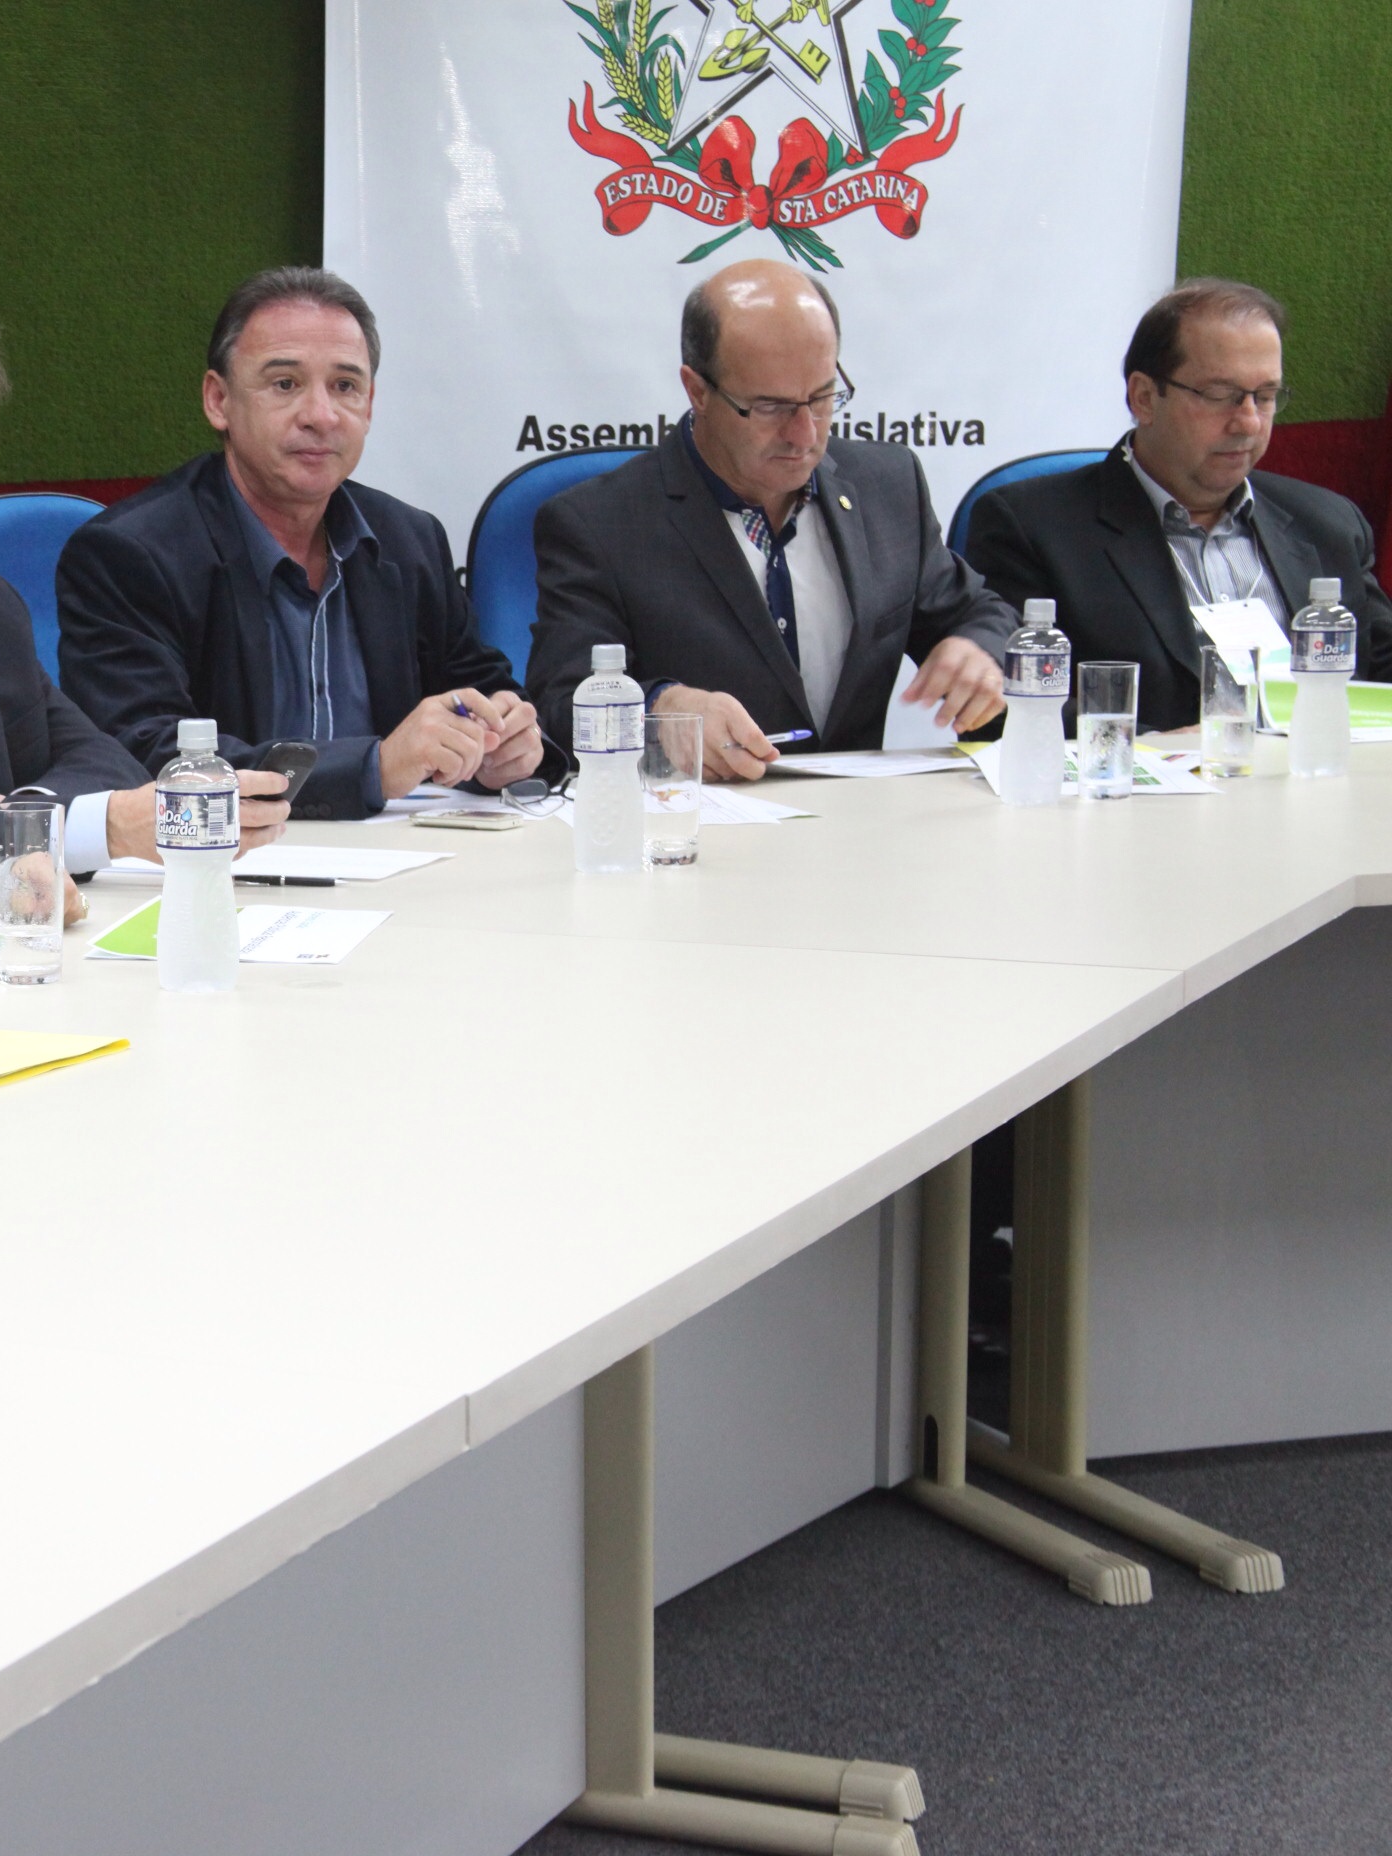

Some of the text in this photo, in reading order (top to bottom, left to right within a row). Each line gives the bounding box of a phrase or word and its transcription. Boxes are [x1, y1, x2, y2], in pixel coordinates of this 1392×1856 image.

[604, 172, 920, 224] ESTADO DE STA. CATARINA
[516, 414, 678, 451] Assemb
[158, 820, 198, 836] Guarda
[165, 809, 182, 825] Da
